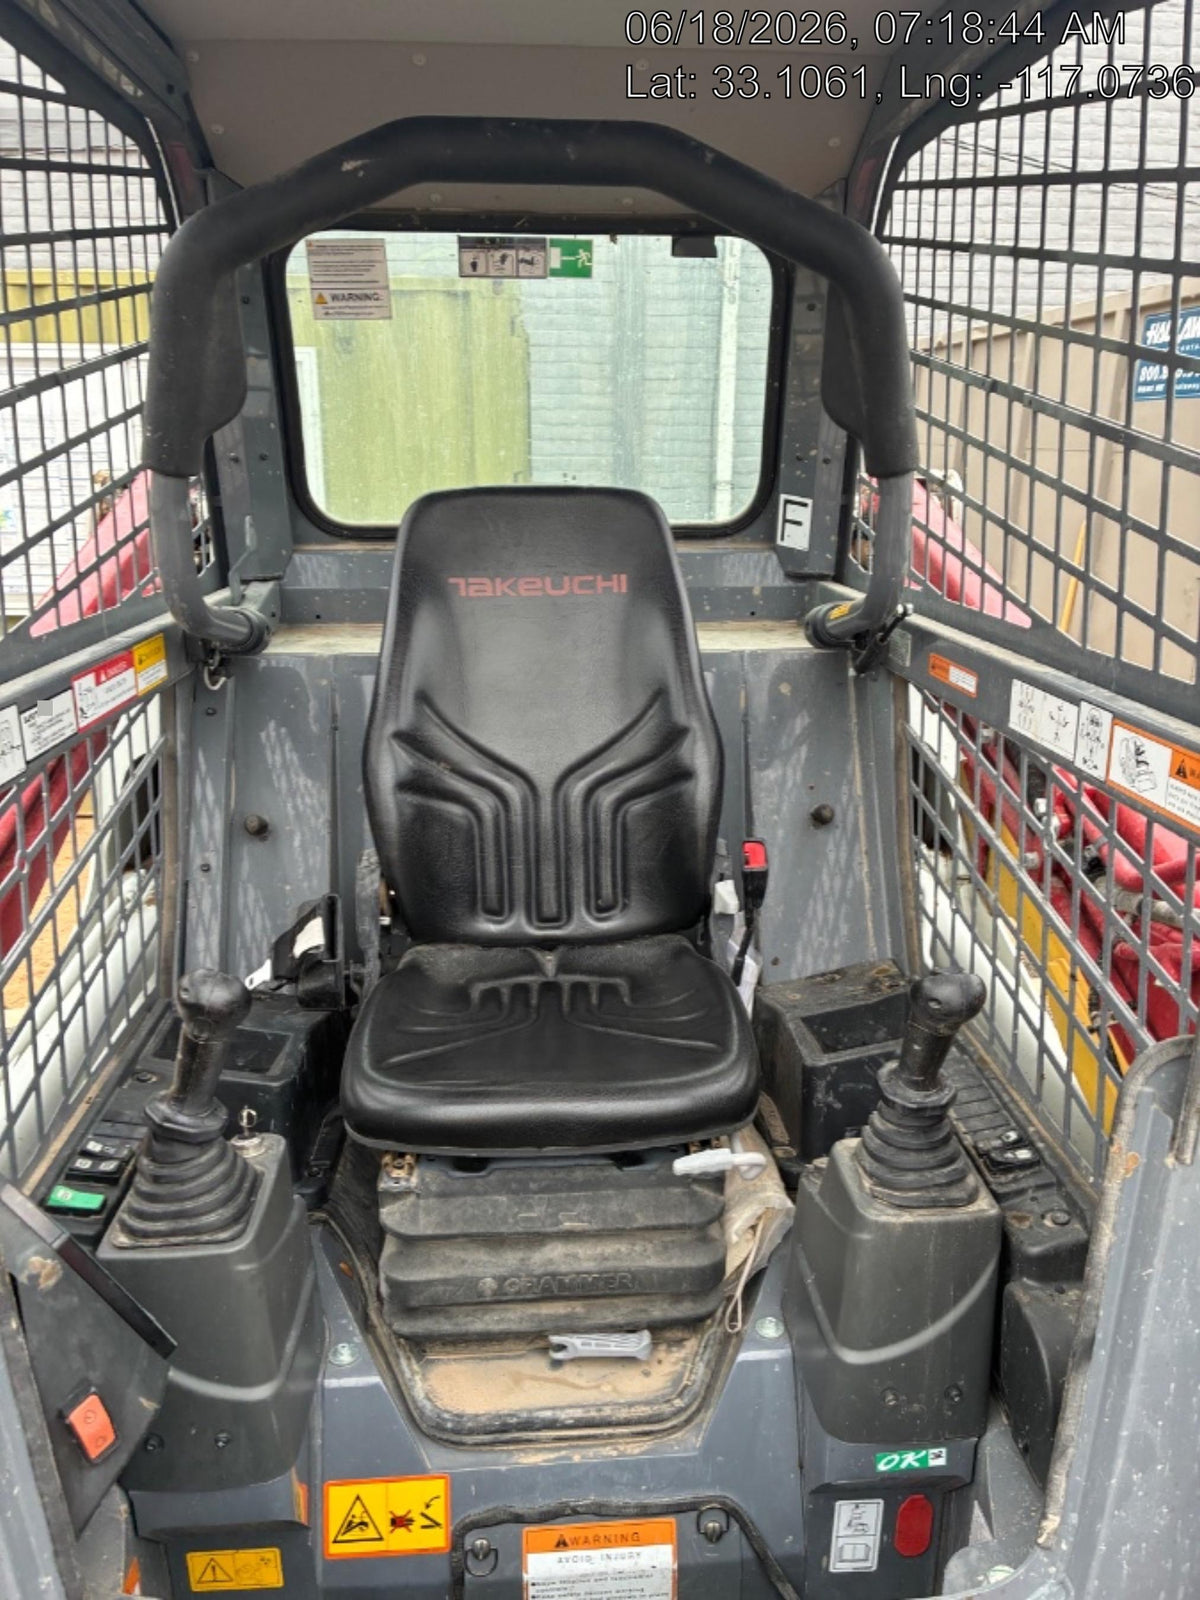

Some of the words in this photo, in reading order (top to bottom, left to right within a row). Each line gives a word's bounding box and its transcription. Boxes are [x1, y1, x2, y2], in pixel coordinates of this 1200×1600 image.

[780, 498, 809, 542] F
[447, 574, 628, 597] TAKEUCHI
[505, 1271, 637, 1294] GRAMMER
[876, 1450, 928, 1471] OK
[569, 1532, 641, 1546] WARNING
[601, 1552, 642, 1562] INJURY
